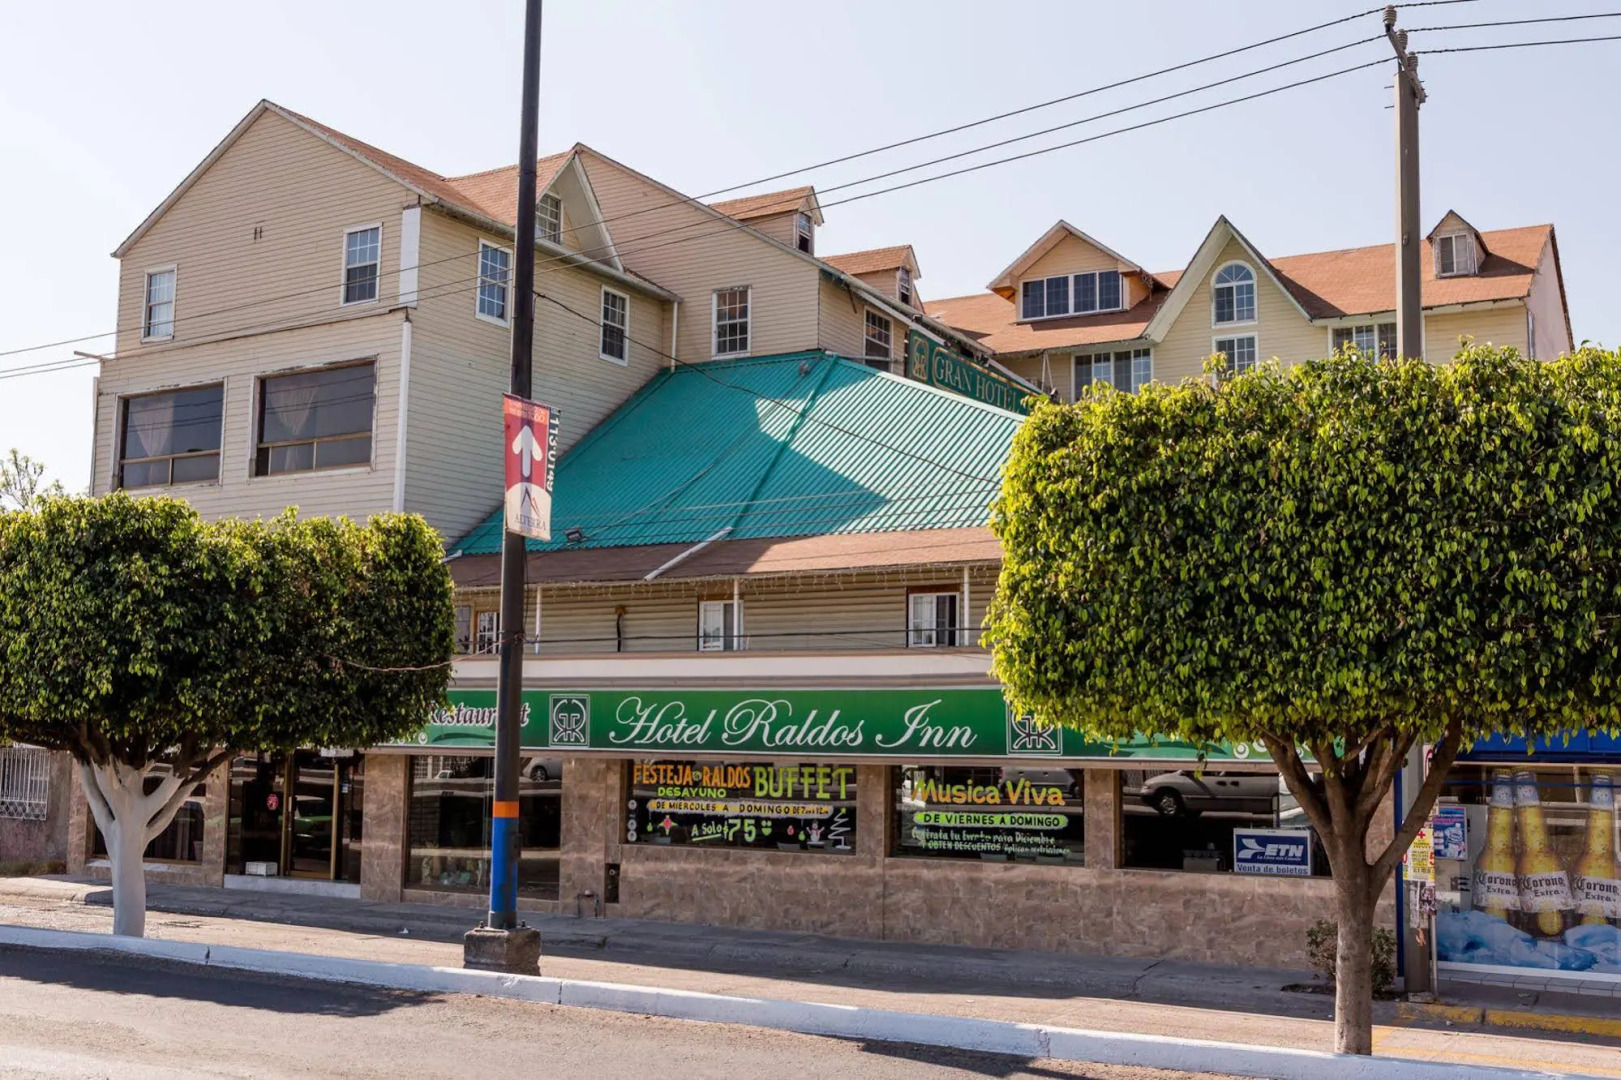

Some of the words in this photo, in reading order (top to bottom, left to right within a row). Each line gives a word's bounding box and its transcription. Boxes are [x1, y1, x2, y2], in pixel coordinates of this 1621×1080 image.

[934, 355, 972, 392] GRAN
[976, 374, 1020, 414] HOTEL
[514, 513, 547, 531] ALTERRA
[608, 696, 717, 744] Hotel
[721, 699, 865, 747] Raldos
[874, 699, 978, 748] Inn
[633, 764, 693, 786] FESTEJA
[702, 765, 751, 788] RALDOS
[753, 766, 854, 799] BUFFET
[657, 787, 727, 799] DESAYUNO
[910, 778, 1001, 804] Musica
[1006, 777, 1066, 806] Viva
[656, 801, 665, 810] DE
[669, 802, 716, 812] MIERCOLES
[722, 804, 729, 812] A
[739, 803, 790, 814] DOMINGO
[923, 813, 940, 823] DE
[945, 814, 995, 825] VIERNES
[999, 816, 1006, 825] A
[1010, 816, 1060, 827] DOMINGO
[691, 824, 699, 837] A
[1265, 844, 1304, 857] ETN
[1237, 864, 1260, 872] Venta
[1263, 865, 1274, 873] de
[1276, 866, 1308, 875] boletos
[1523, 874, 1565, 890] Corona
[1576, 877, 1620, 893] Corona
[1486, 886, 1511, 895] Extra
[1534, 889, 1560, 898] Extra
[1585, 892, 1611, 901] Extra
